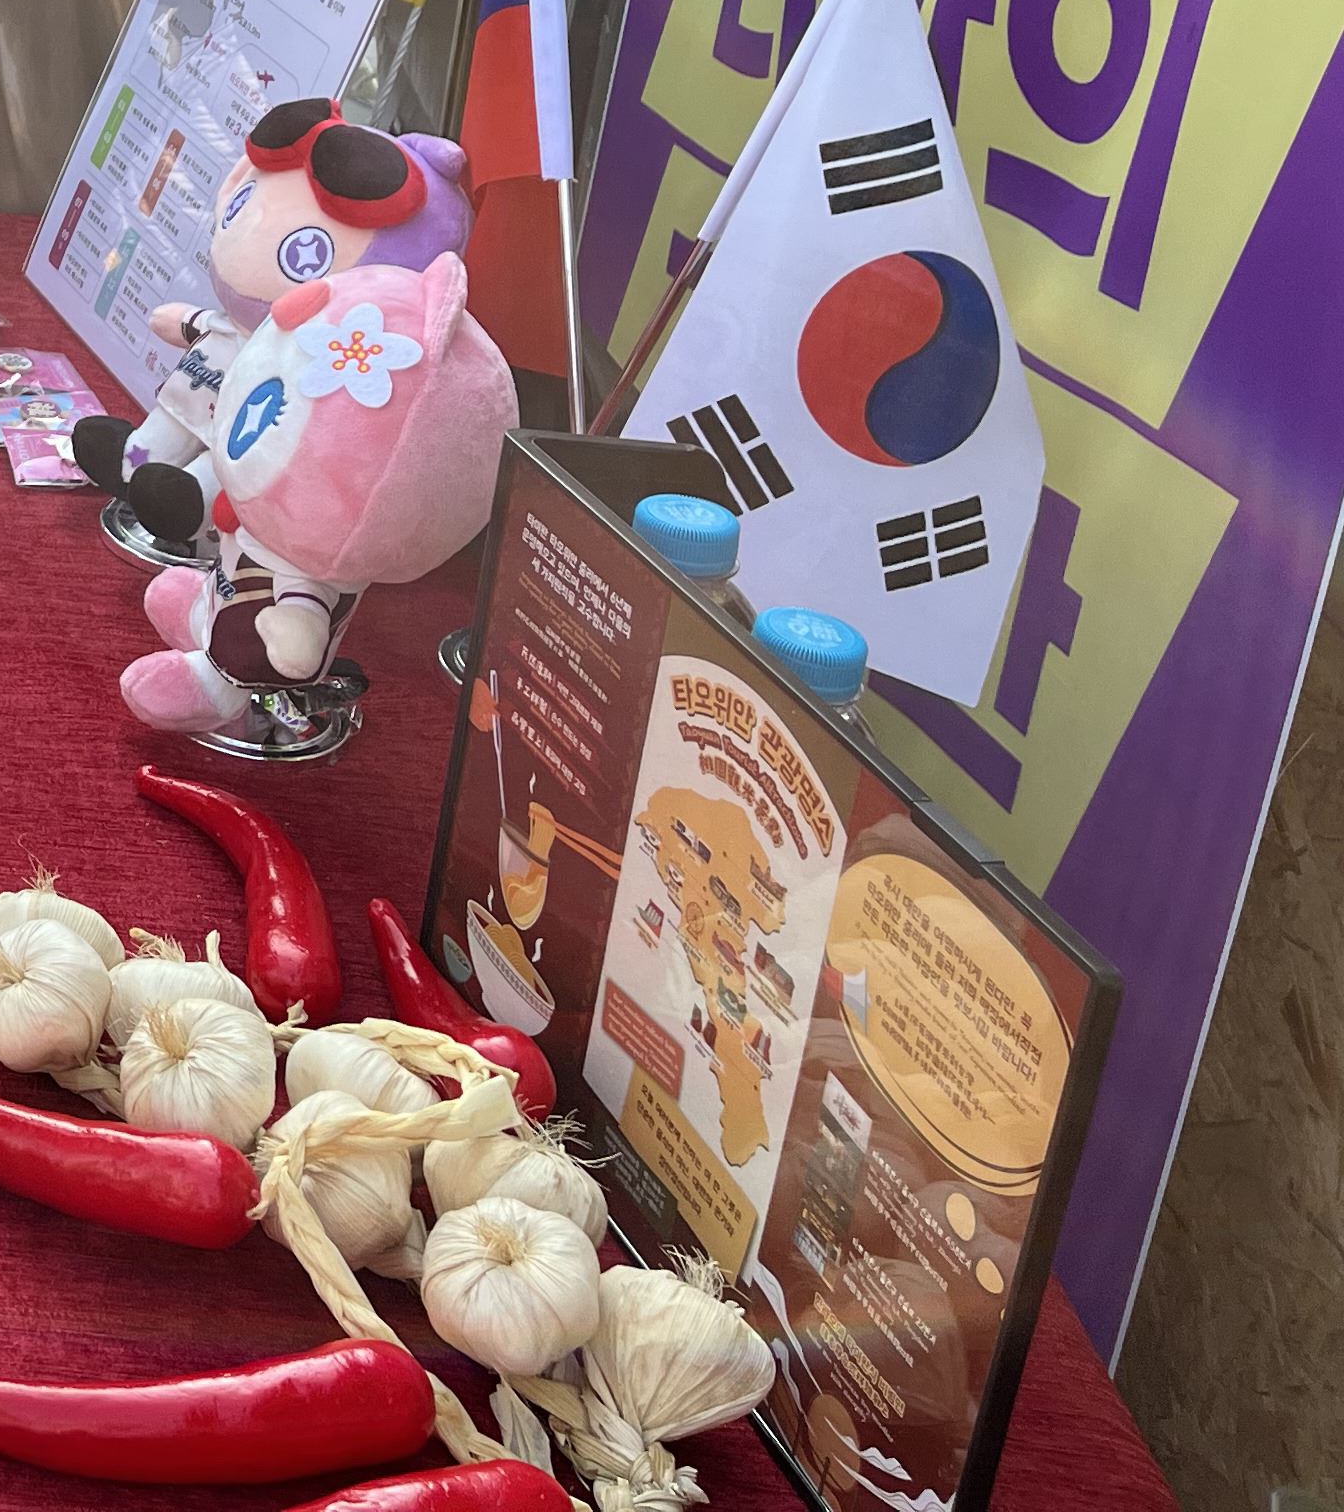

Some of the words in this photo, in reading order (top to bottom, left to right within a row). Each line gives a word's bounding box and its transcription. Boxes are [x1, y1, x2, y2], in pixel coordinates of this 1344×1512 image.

[522, 527, 556, 568] 운영해오고
[550, 533, 577, 569] 타오위안
[579, 561, 609, 598] 중리에서
[671, 676, 756, 739] 타오위안
[759, 718, 833, 854] 관광명소
[863, 899, 880, 926] 만든
[953, 992, 989, 1039] 맛보시길
[991, 1037, 1038, 1087] 바랍니다!
[867, 880, 900, 925] 타오위안
[902, 920, 932, 957] 중리에
[935, 952, 956, 980] 들러
[960, 975, 977, 999] 저희
[884, 874, 901, 900] 혹시
[902, 896, 930, 932] 대만을
[933, 925, 982, 985] 여행하시게
[1021, 1011, 1033, 1031] 꼭
[641, 1084, 653, 1105] 오늘
